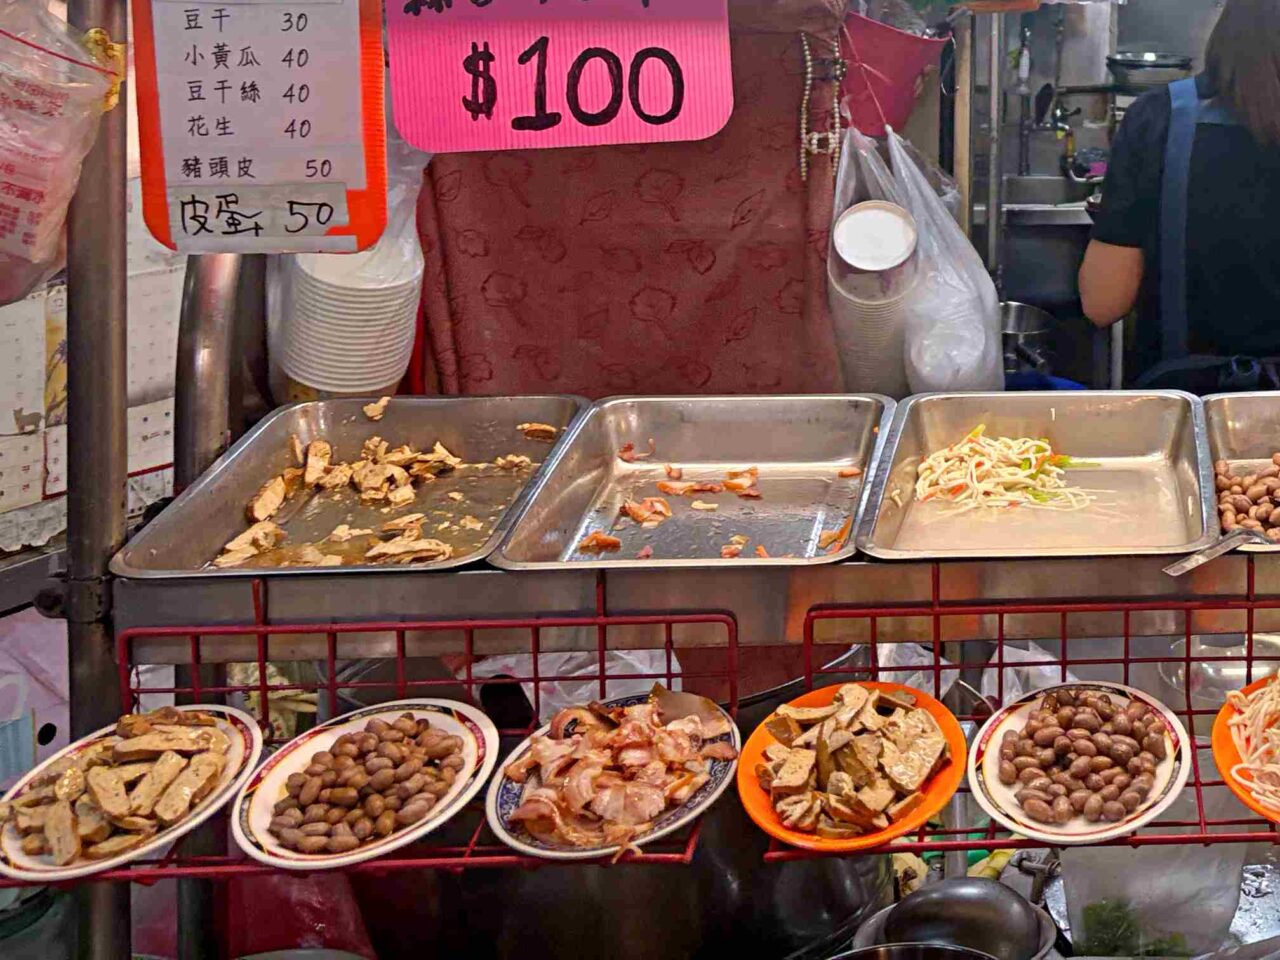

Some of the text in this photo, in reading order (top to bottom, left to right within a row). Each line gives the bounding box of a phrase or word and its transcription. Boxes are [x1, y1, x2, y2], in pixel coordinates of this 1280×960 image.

[184, 8, 308, 32] 豆干 30
[185, 44, 309, 69] 小黃瓜 40
[187, 80, 310, 104] 豆干絲 40
[462, 36, 685, 131] $100
[187, 116, 312, 138] 花生 40
[181, 157, 332, 179] 豬頭皮 50
[180, 194, 334, 237] 皮蛋 50
